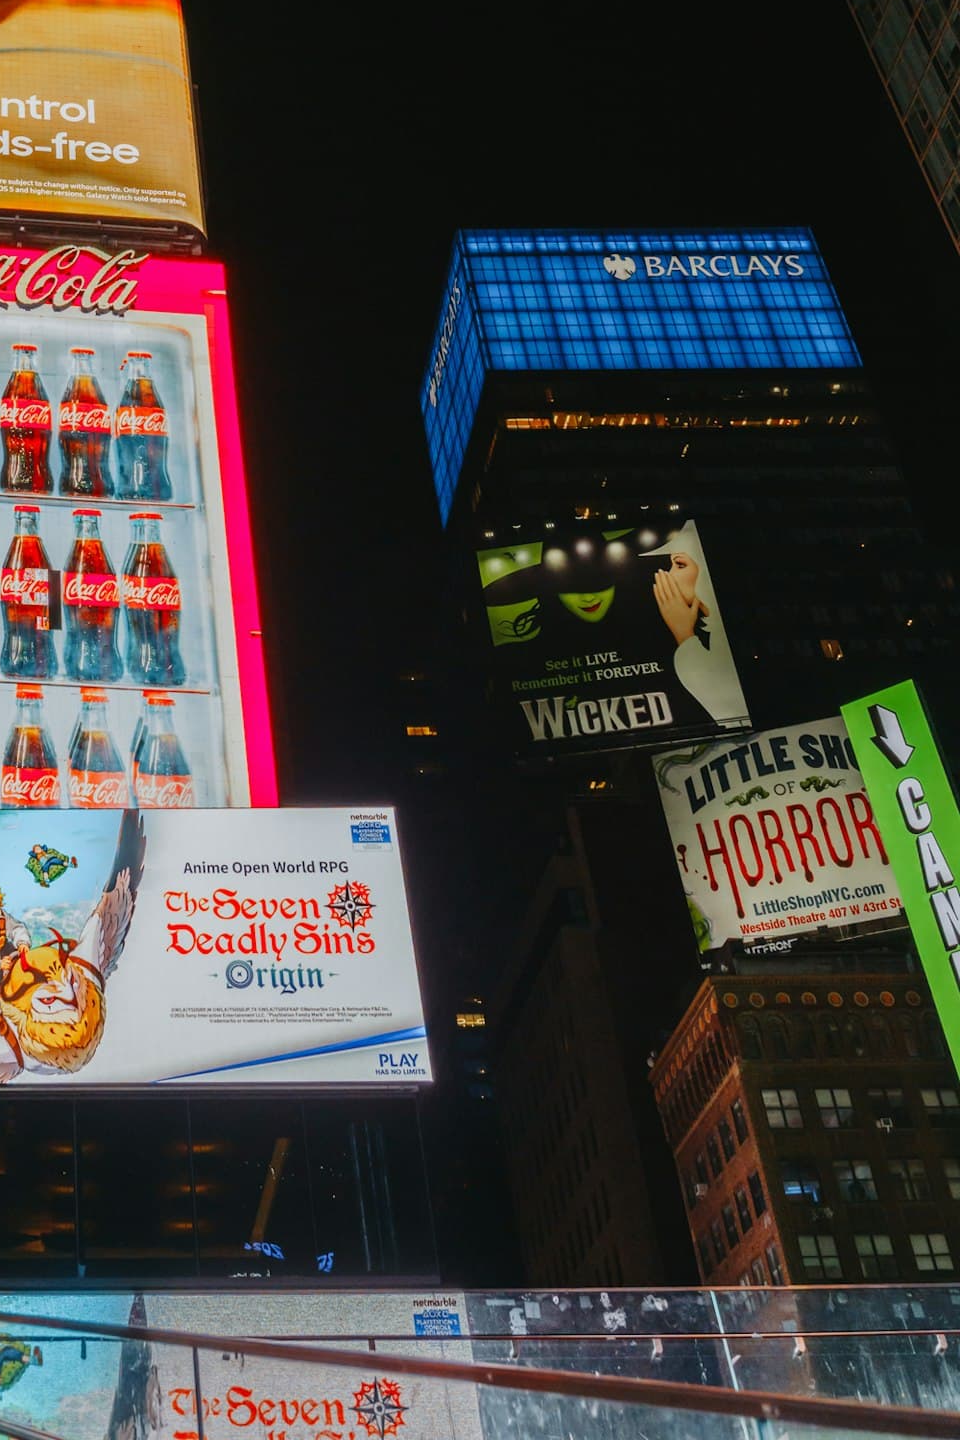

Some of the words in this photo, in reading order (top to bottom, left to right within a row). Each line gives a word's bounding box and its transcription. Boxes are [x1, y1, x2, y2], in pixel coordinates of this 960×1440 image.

[645, 254, 805, 279] BARCLAYS
[544, 659, 569, 671] See
[572, 656, 582, 668] it
[585, 651, 622, 667] LIVE.
[512, 673, 580, 691] Remember
[582, 671, 593, 683] it
[595, 661, 664, 681] FOREVER.
[683, 737, 797, 815] LITTLE
[773, 779, 797, 798] OF
[350, 812, 388, 821] netmarble
[183, 861, 229, 875] Anime
[232, 862, 270, 877] Open
[273, 861, 316, 874] World
[319, 861, 349, 874] RPG
[163, 890, 210, 917] The
[212, 887, 321, 920] Seven
[753, 883, 886, 917] LittleShopNYC.com
[740, 918, 786, 935] Westside
[787, 911, 827, 927] Theatre
[828, 906, 848, 919] 407
[849, 904, 861, 916] W
[863, 900, 888, 913] 43rd
[890, 897, 902, 909] St
[166, 921, 288, 962] Deadly
[293, 921, 376, 955] Sins
[225, 959, 325, 995] Origin
[375, 1068, 390, 1076] HAS
[402, 1068, 426, 1076] LIMITS
[378, 1053, 419, 1068] PLAY
[413, 1297, 457, 1307] netmarble
[226, 1385, 346, 1427] Seven
